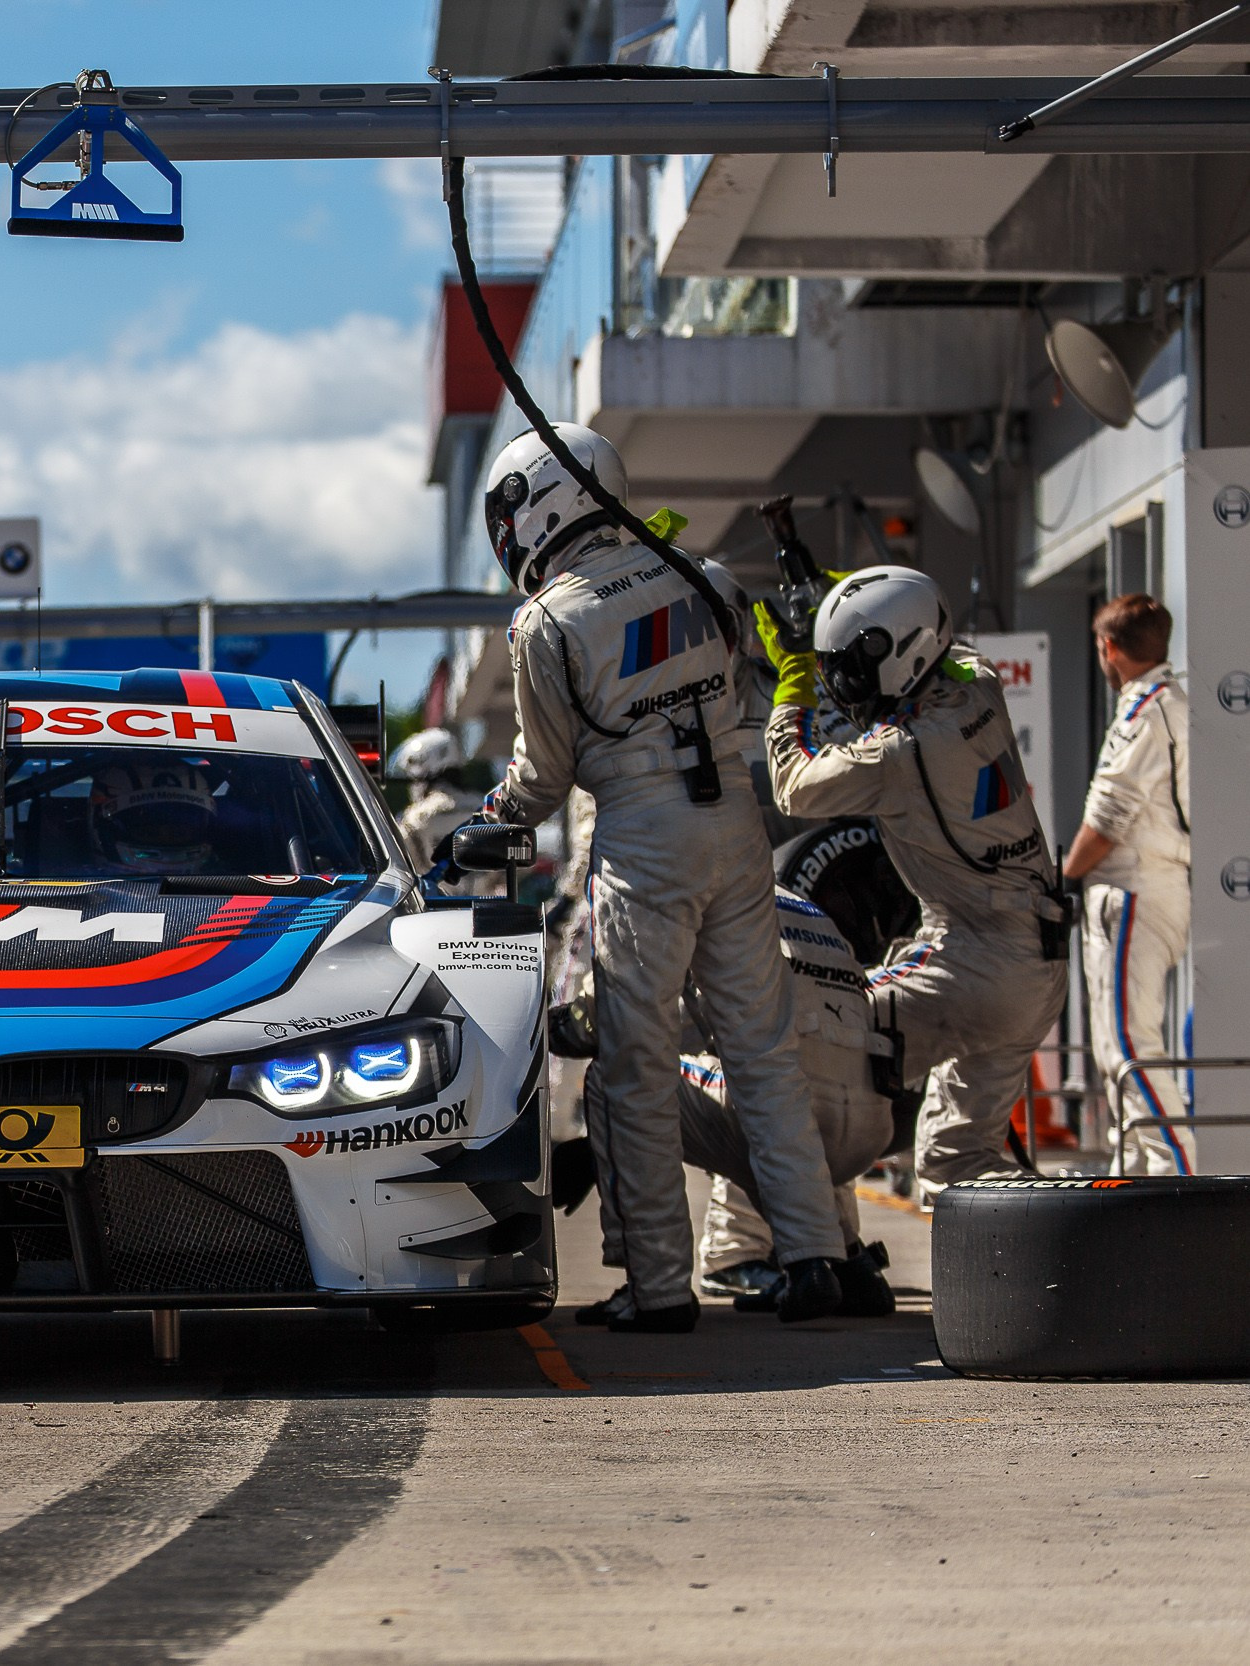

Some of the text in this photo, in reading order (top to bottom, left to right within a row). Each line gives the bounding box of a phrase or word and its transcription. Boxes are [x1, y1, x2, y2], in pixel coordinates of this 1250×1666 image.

[595, 562, 672, 601] BMW Team
[437, 941, 538, 953] BMW Driving
[452, 951, 539, 963] Experience
[437, 963, 512, 972] bmw-m.com
[335, 1009, 379, 1023] ULTRA
